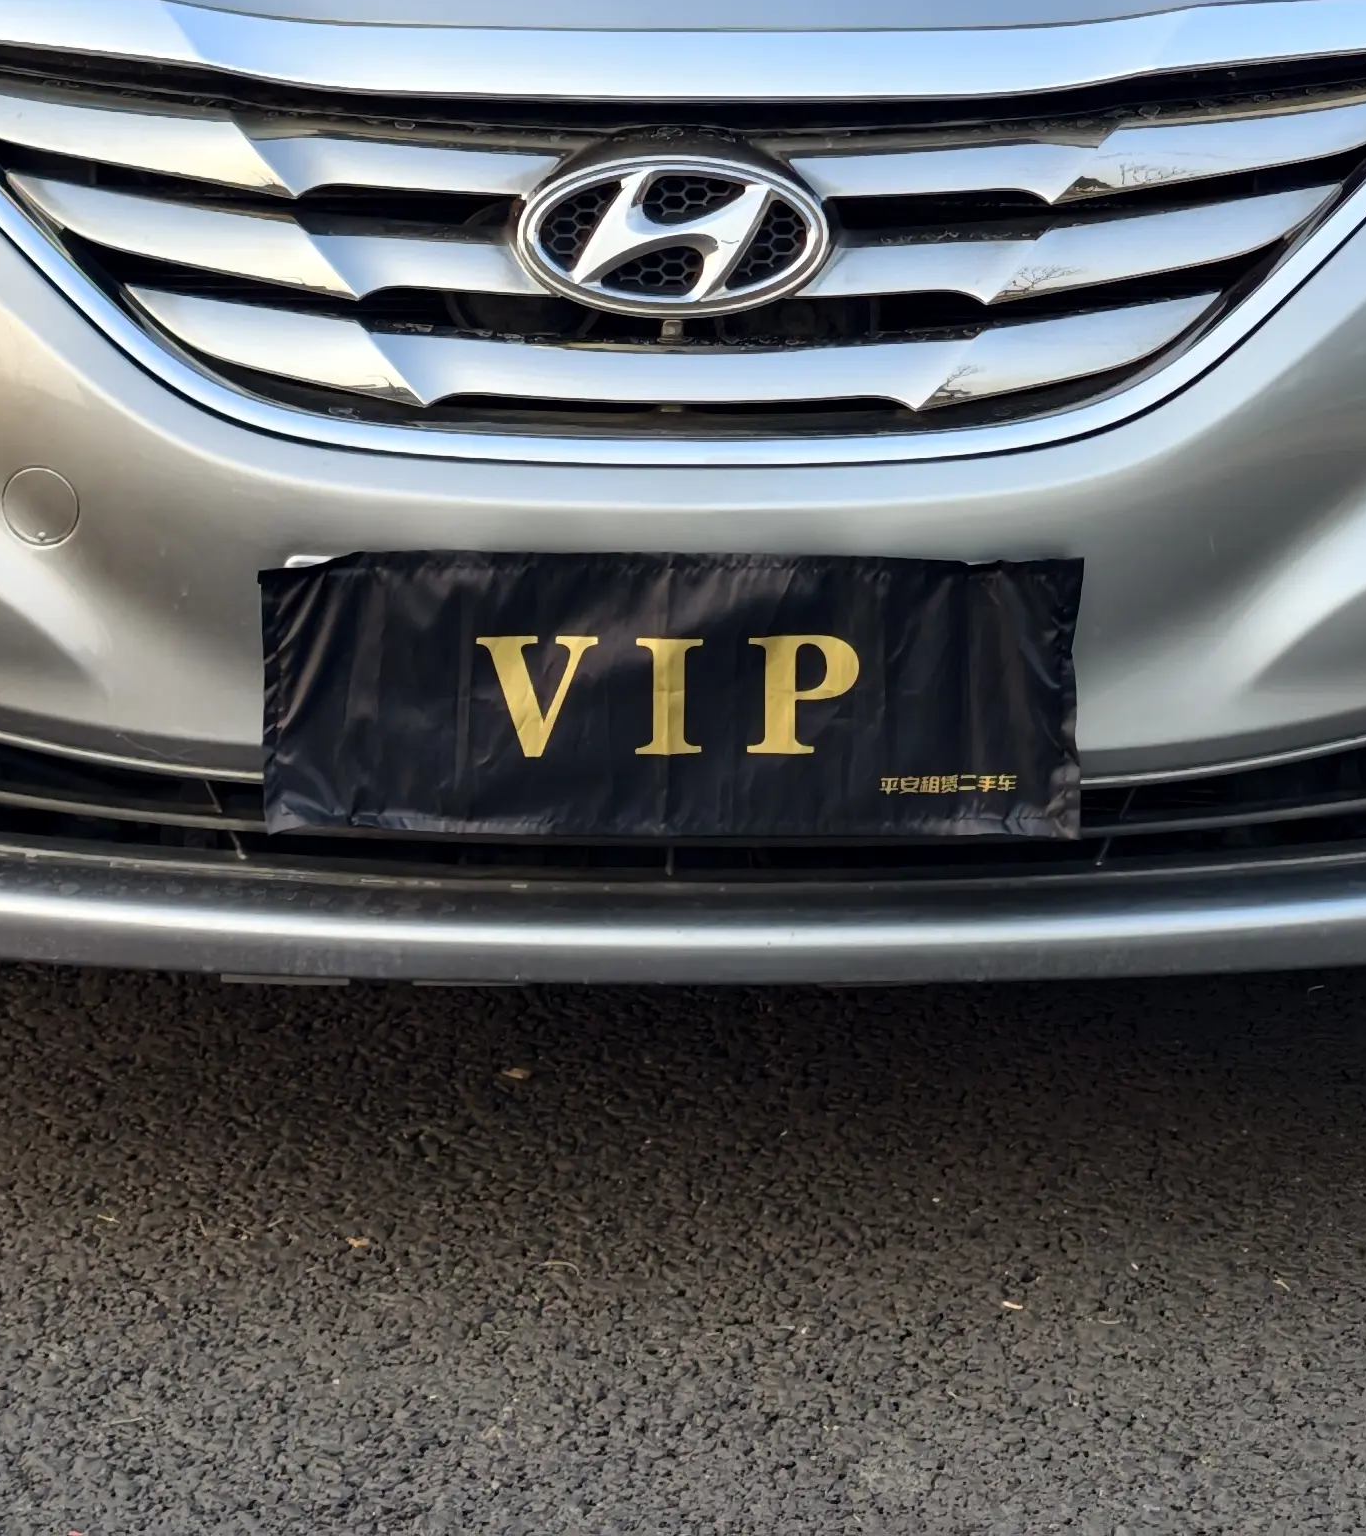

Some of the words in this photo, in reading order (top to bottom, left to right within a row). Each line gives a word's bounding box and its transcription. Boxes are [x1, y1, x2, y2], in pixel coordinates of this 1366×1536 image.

[476, 634, 860, 758] VIP
[878, 773, 1018, 795] 平安租赁二手车
